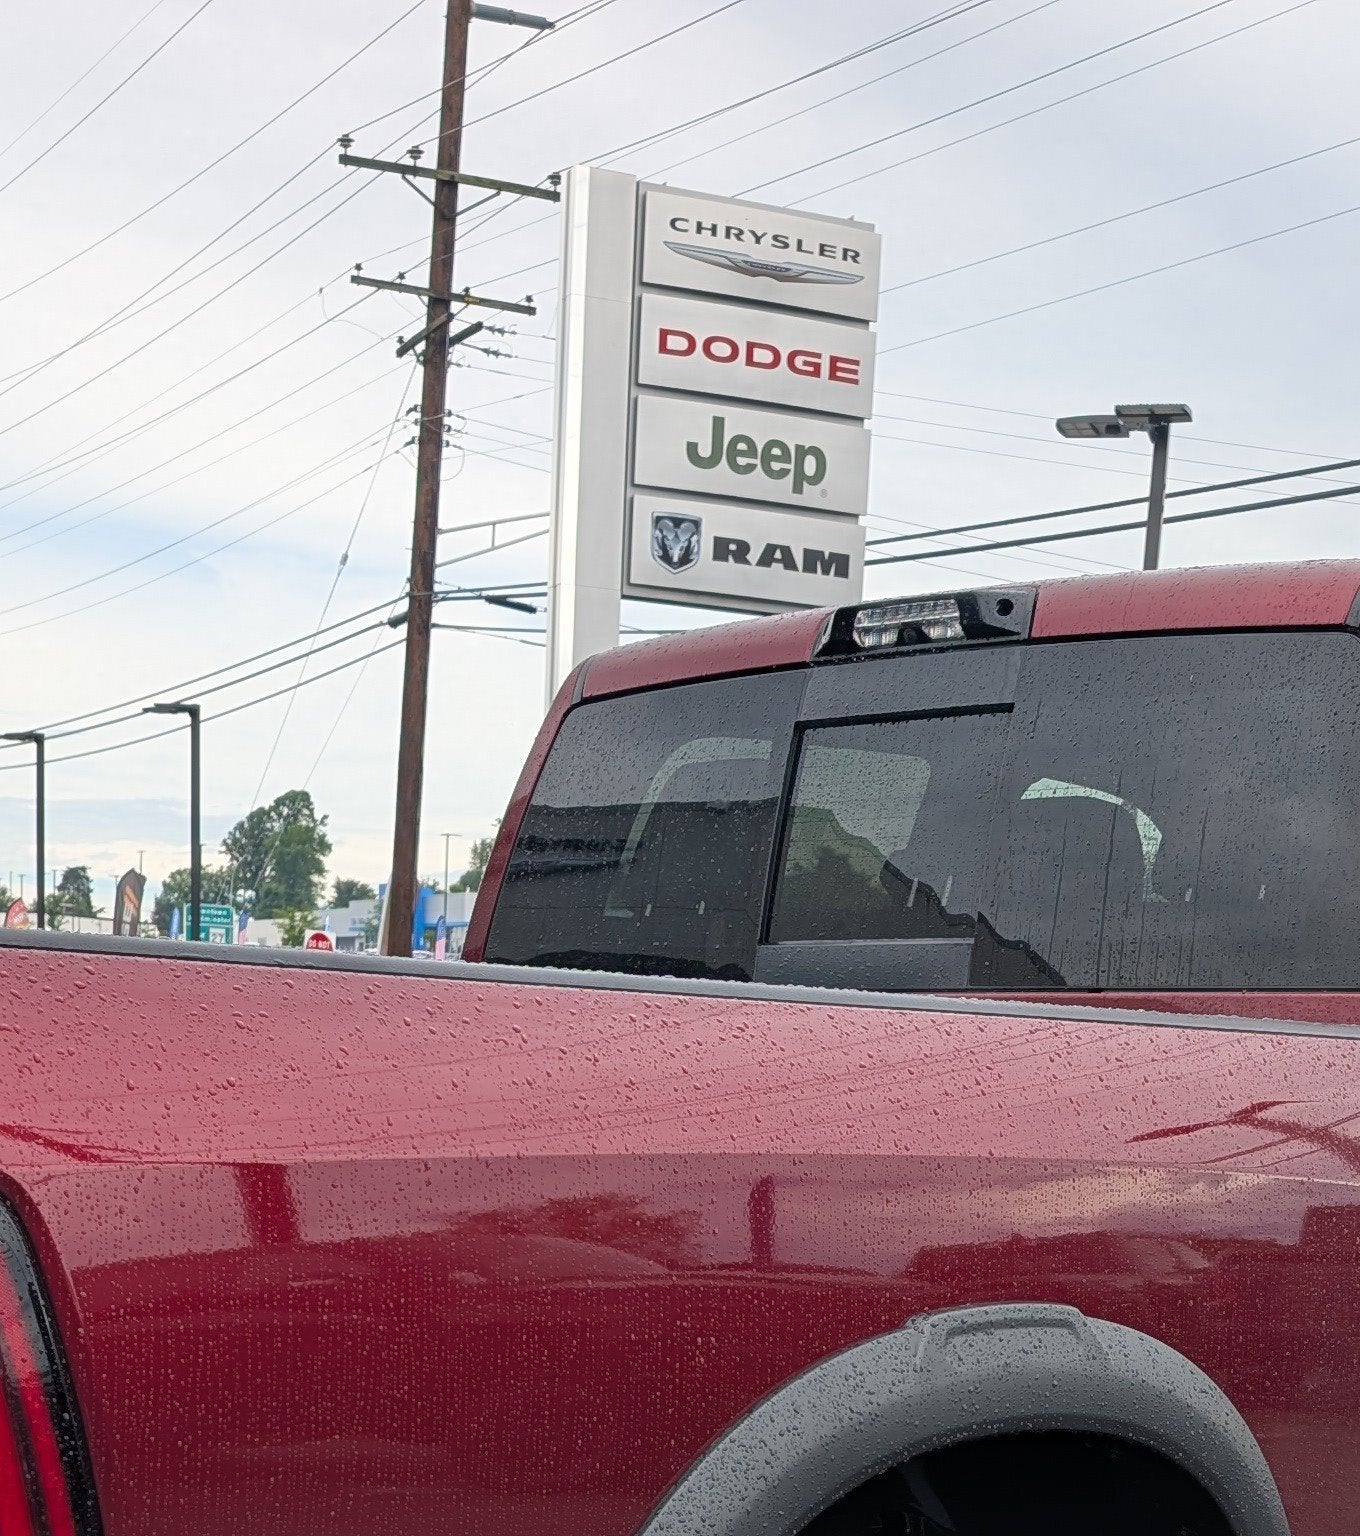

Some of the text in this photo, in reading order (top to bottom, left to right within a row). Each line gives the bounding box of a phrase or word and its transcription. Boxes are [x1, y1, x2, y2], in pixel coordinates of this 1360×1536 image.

[669, 216, 862, 265] CHRYSLER
[657, 327, 861, 386] DODGE
[685, 415, 827, 495] Jeep
[711, 535, 850, 580] RAM
